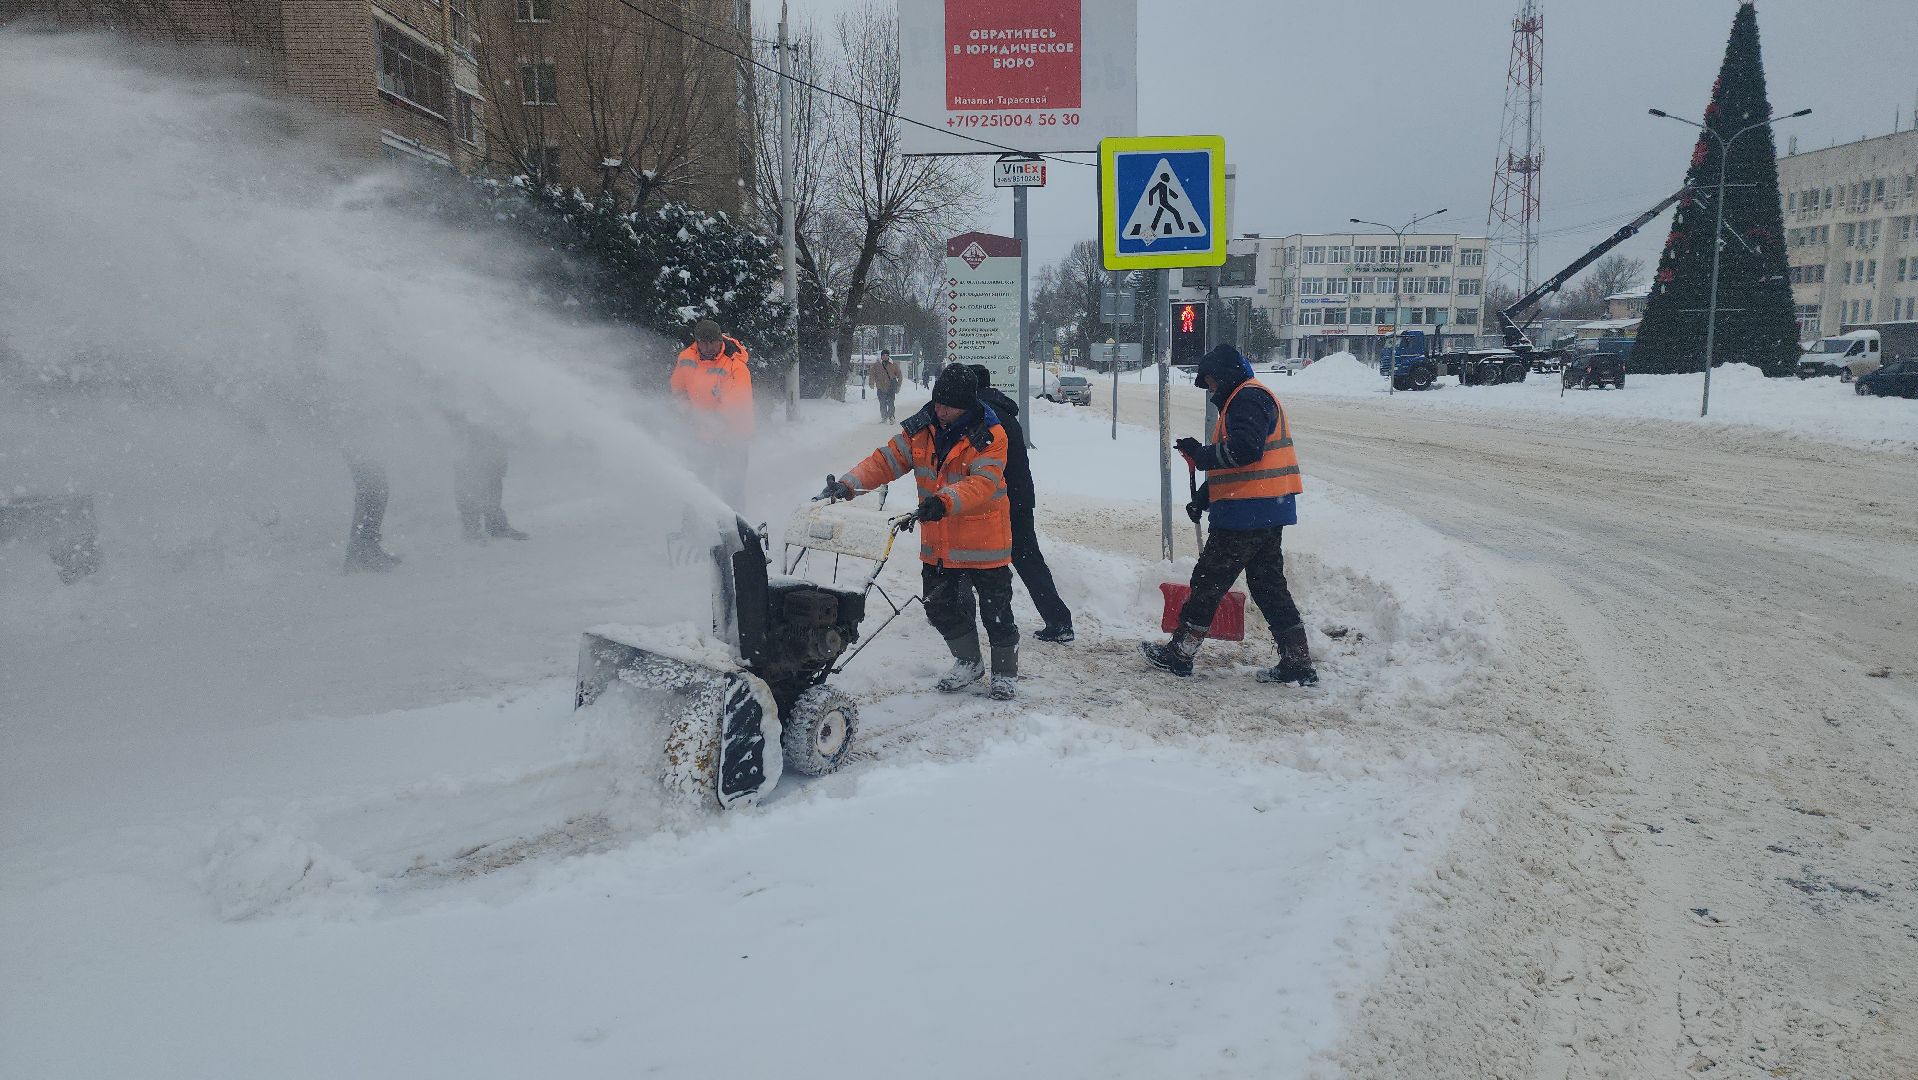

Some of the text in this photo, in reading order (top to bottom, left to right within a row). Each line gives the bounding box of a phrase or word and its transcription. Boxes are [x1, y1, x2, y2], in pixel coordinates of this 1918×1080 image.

[969, 28, 1057, 40] ОБРАТИТЕСЬ
[953, 42, 1074, 55] В ЮРИДИЧЕСКОЕ
[993, 57, 1035, 69] БЮРО
[954, 95, 1047, 106] Натальи Тарасовой
[1038, 113, 1057, 126] 56
[1062, 113, 1080, 126] 30
[1003, 163, 1039, 174] VinEx
